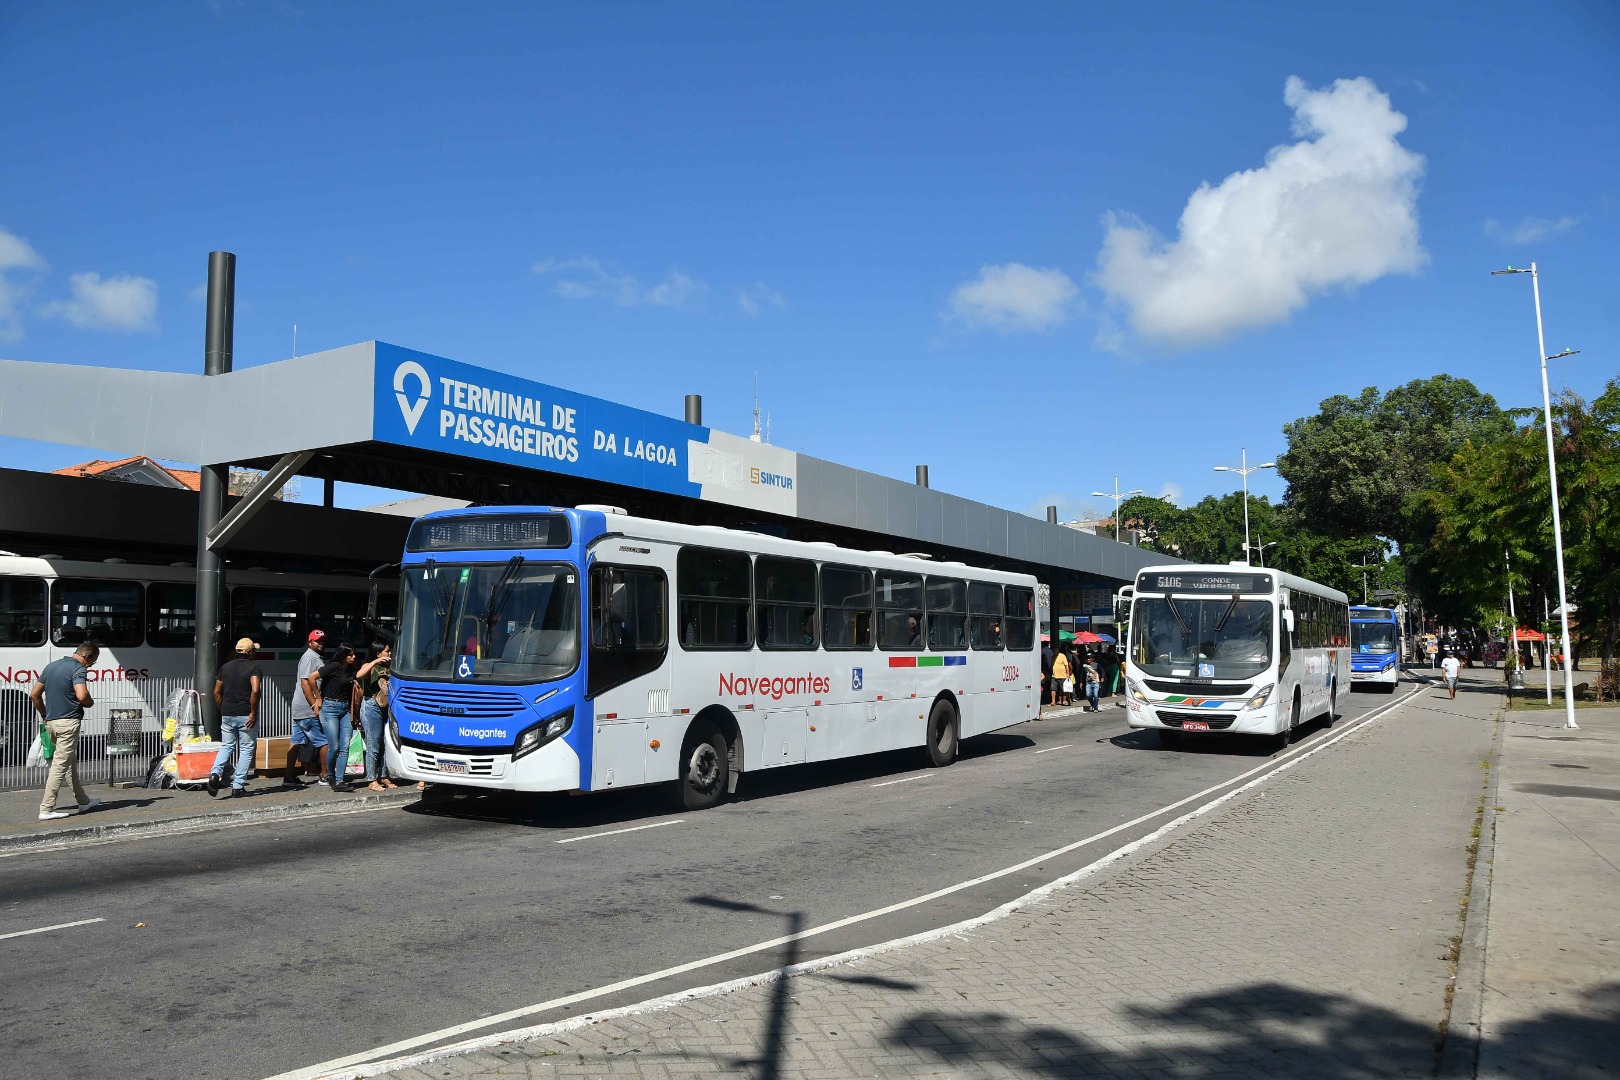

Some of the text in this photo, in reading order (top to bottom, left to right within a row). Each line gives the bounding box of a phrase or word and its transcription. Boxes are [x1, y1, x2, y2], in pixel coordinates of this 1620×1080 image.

[439, 376, 577, 434] TERMINAL DE
[439, 409, 579, 463] PASSAGEIROS
[593, 430, 677, 467] DA LAGOA
[761, 471, 793, 490] SINTUR
[503, 522, 518, 541] DO
[521, 521, 543, 540] SOL
[1158, 576, 1182, 588] 5106
[0, 666, 149, 684] Naantes
[718, 672, 830, 700] Navegantes
[410, 721, 435, 736] 02034
[459, 726, 507, 740] Navegantes
